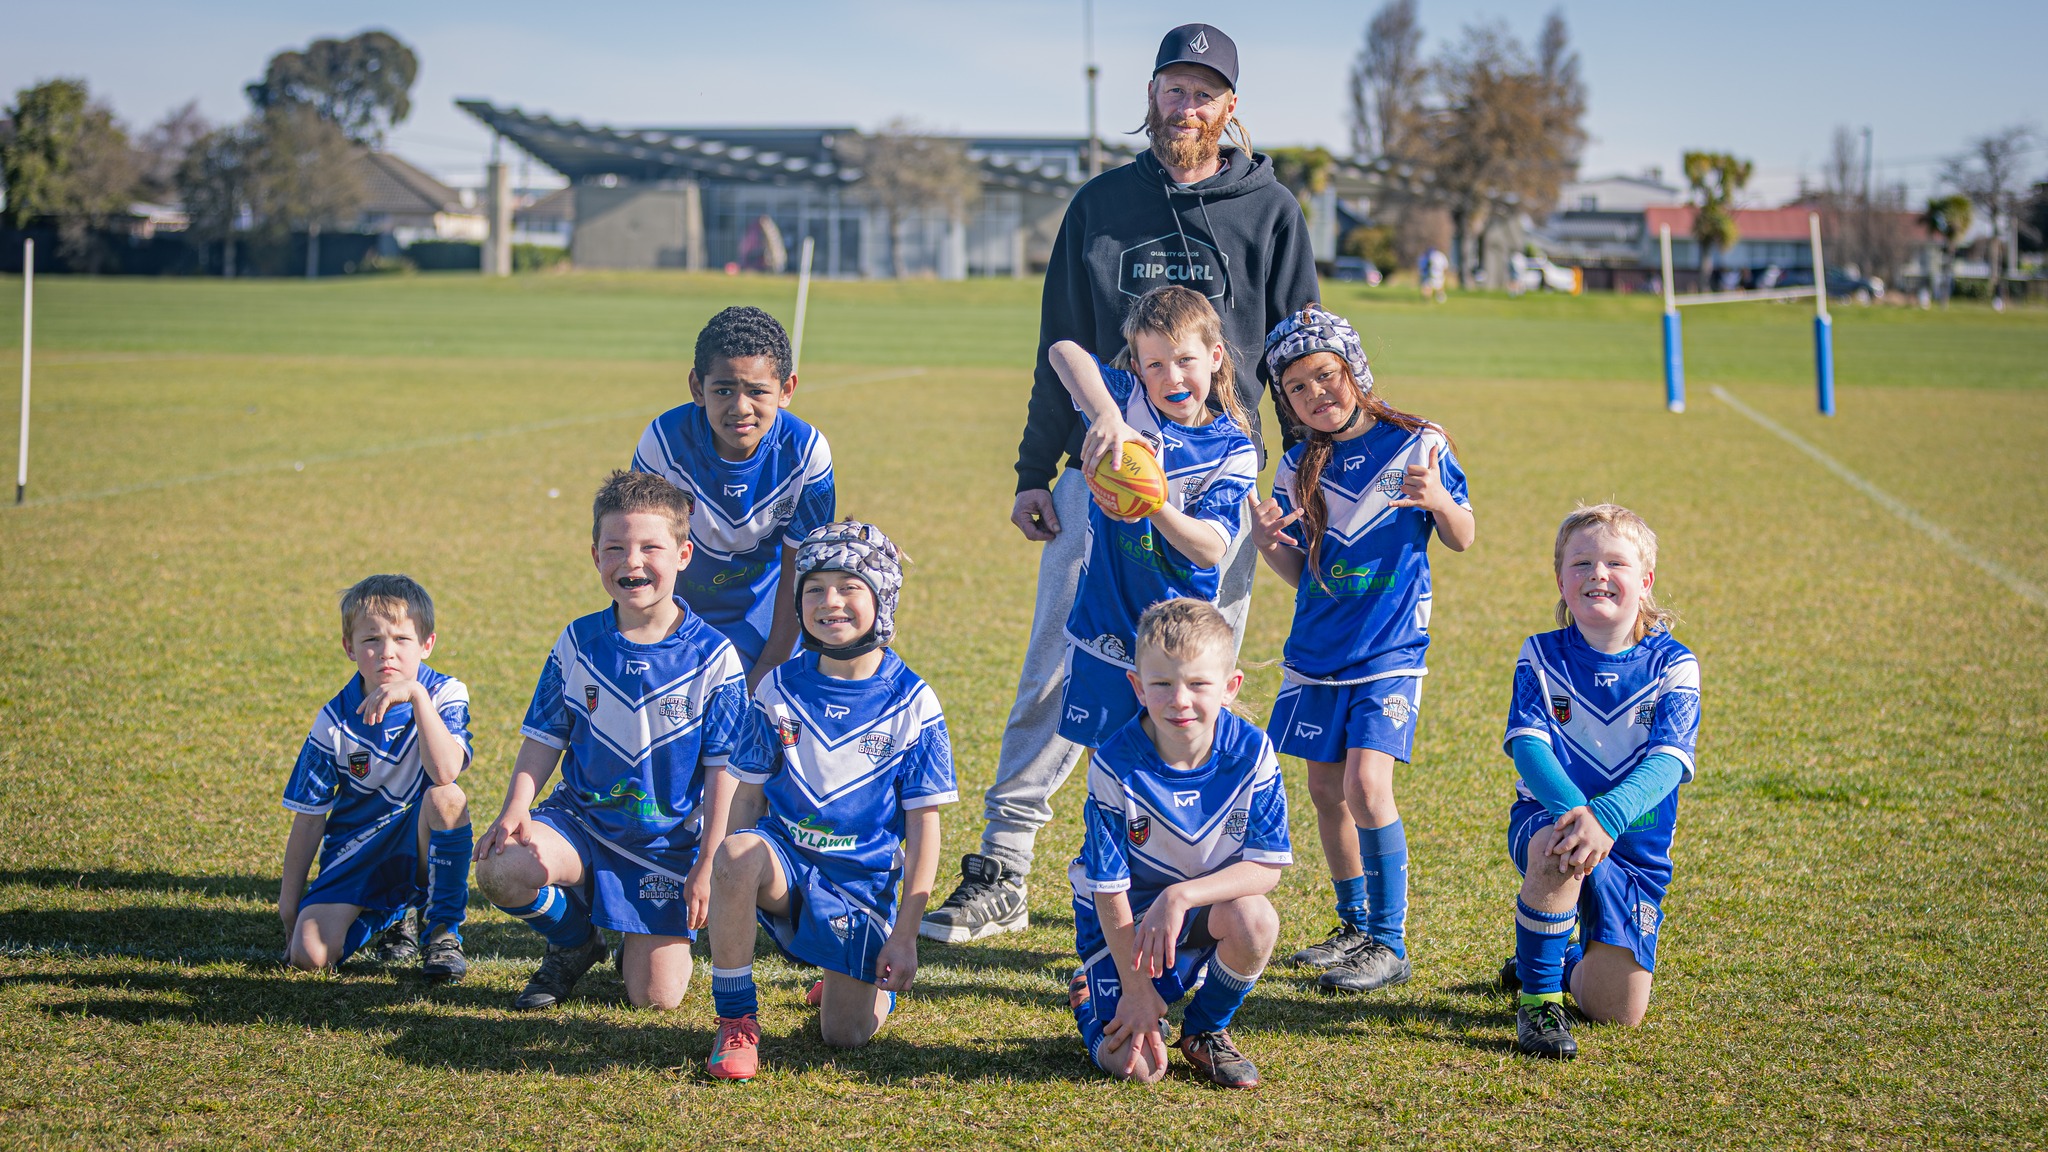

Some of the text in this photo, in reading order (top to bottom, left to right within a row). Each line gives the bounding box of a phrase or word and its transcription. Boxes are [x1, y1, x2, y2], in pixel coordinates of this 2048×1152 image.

[1635, 705, 1654, 714] NORT
[785, 822, 854, 849] SYLAWN
[639, 875, 680, 888] NORTHERN
[639, 889, 680, 900] BULLDOGS
